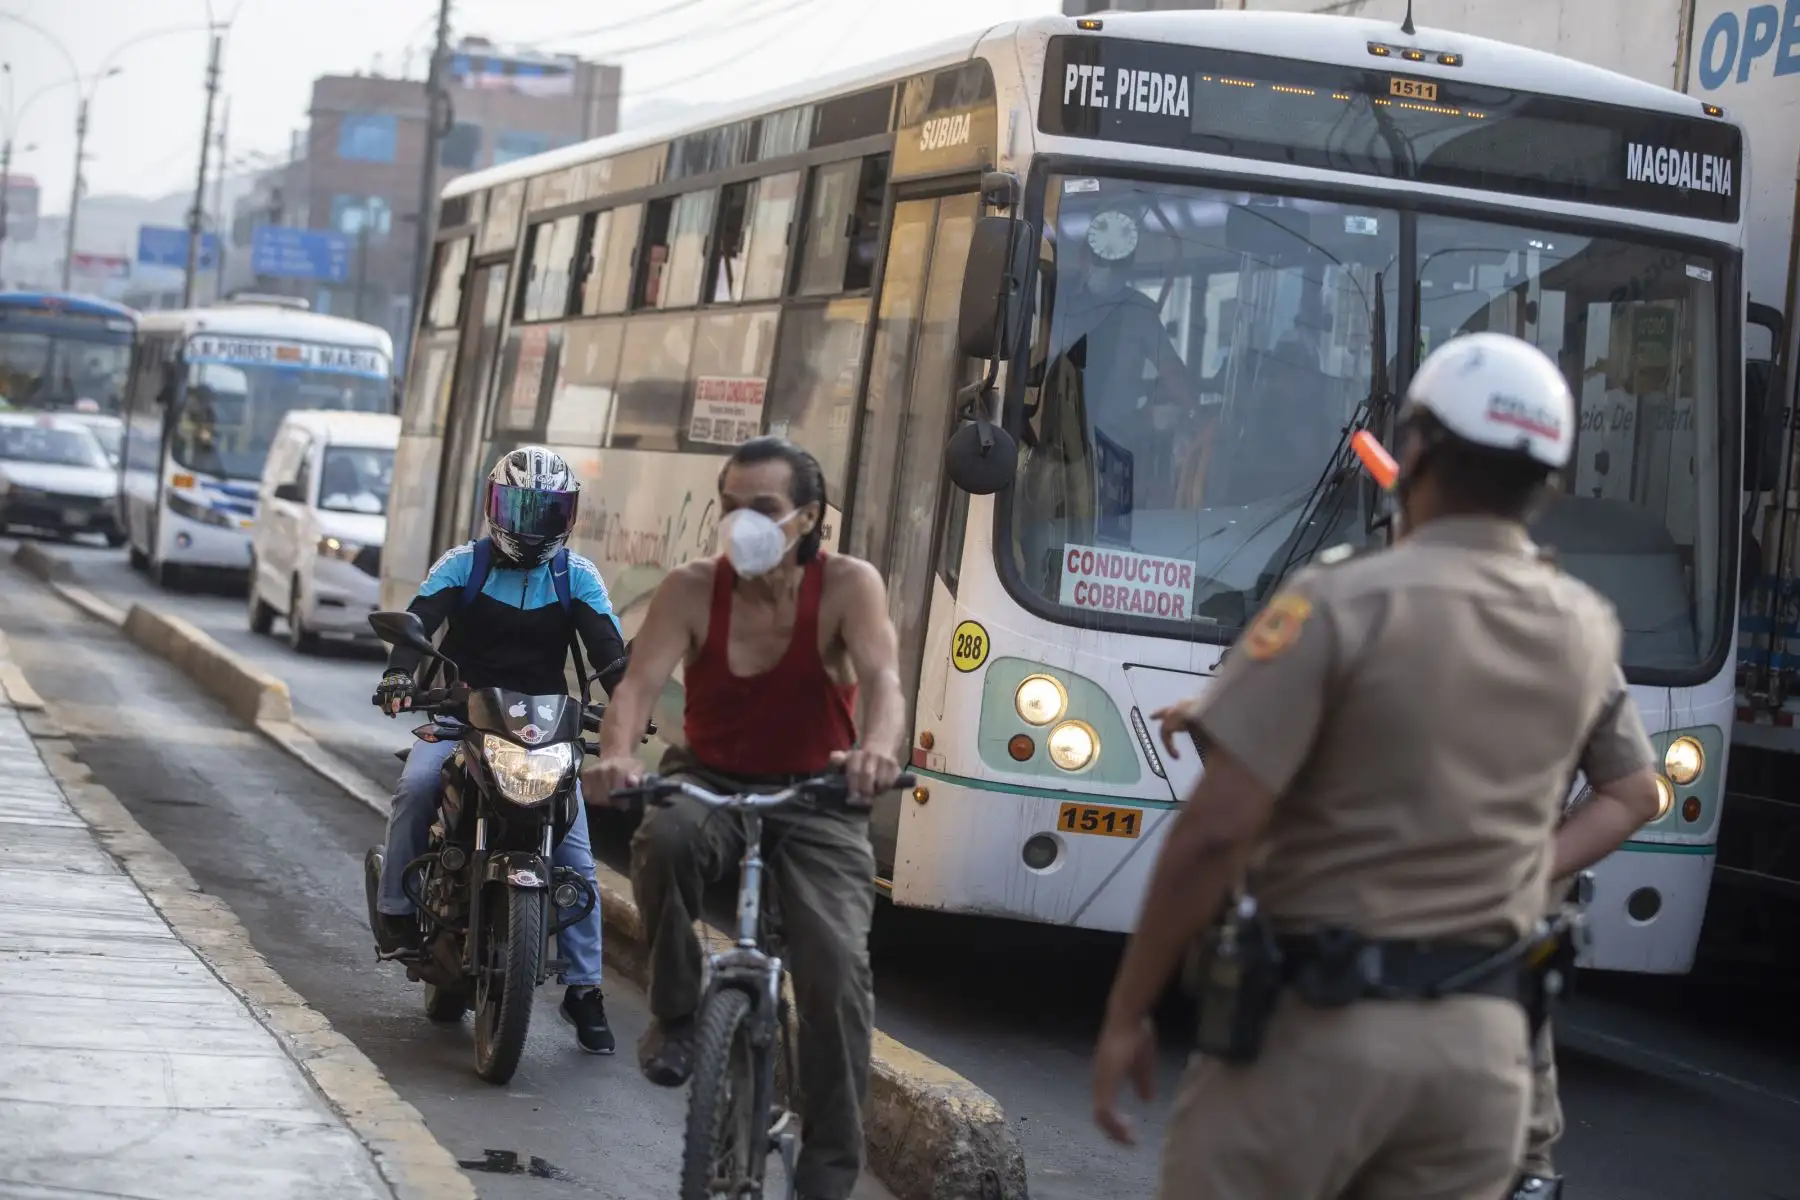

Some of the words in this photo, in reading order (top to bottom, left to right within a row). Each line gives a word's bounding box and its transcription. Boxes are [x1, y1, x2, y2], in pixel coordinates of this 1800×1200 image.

[1064, 63, 1108, 108] PTE.
[1115, 68, 1190, 118] PIEDRA
[1393, 80, 1434, 98] 1511
[920, 112, 971, 152] SUBIDA
[1626, 142, 1732, 197] MAGDALENA
[1067, 549, 1192, 590] CONDUCTOR
[1073, 580, 1185, 619] COBRADOR
[956, 633, 982, 660] 288
[1063, 807, 1135, 835] 1511
